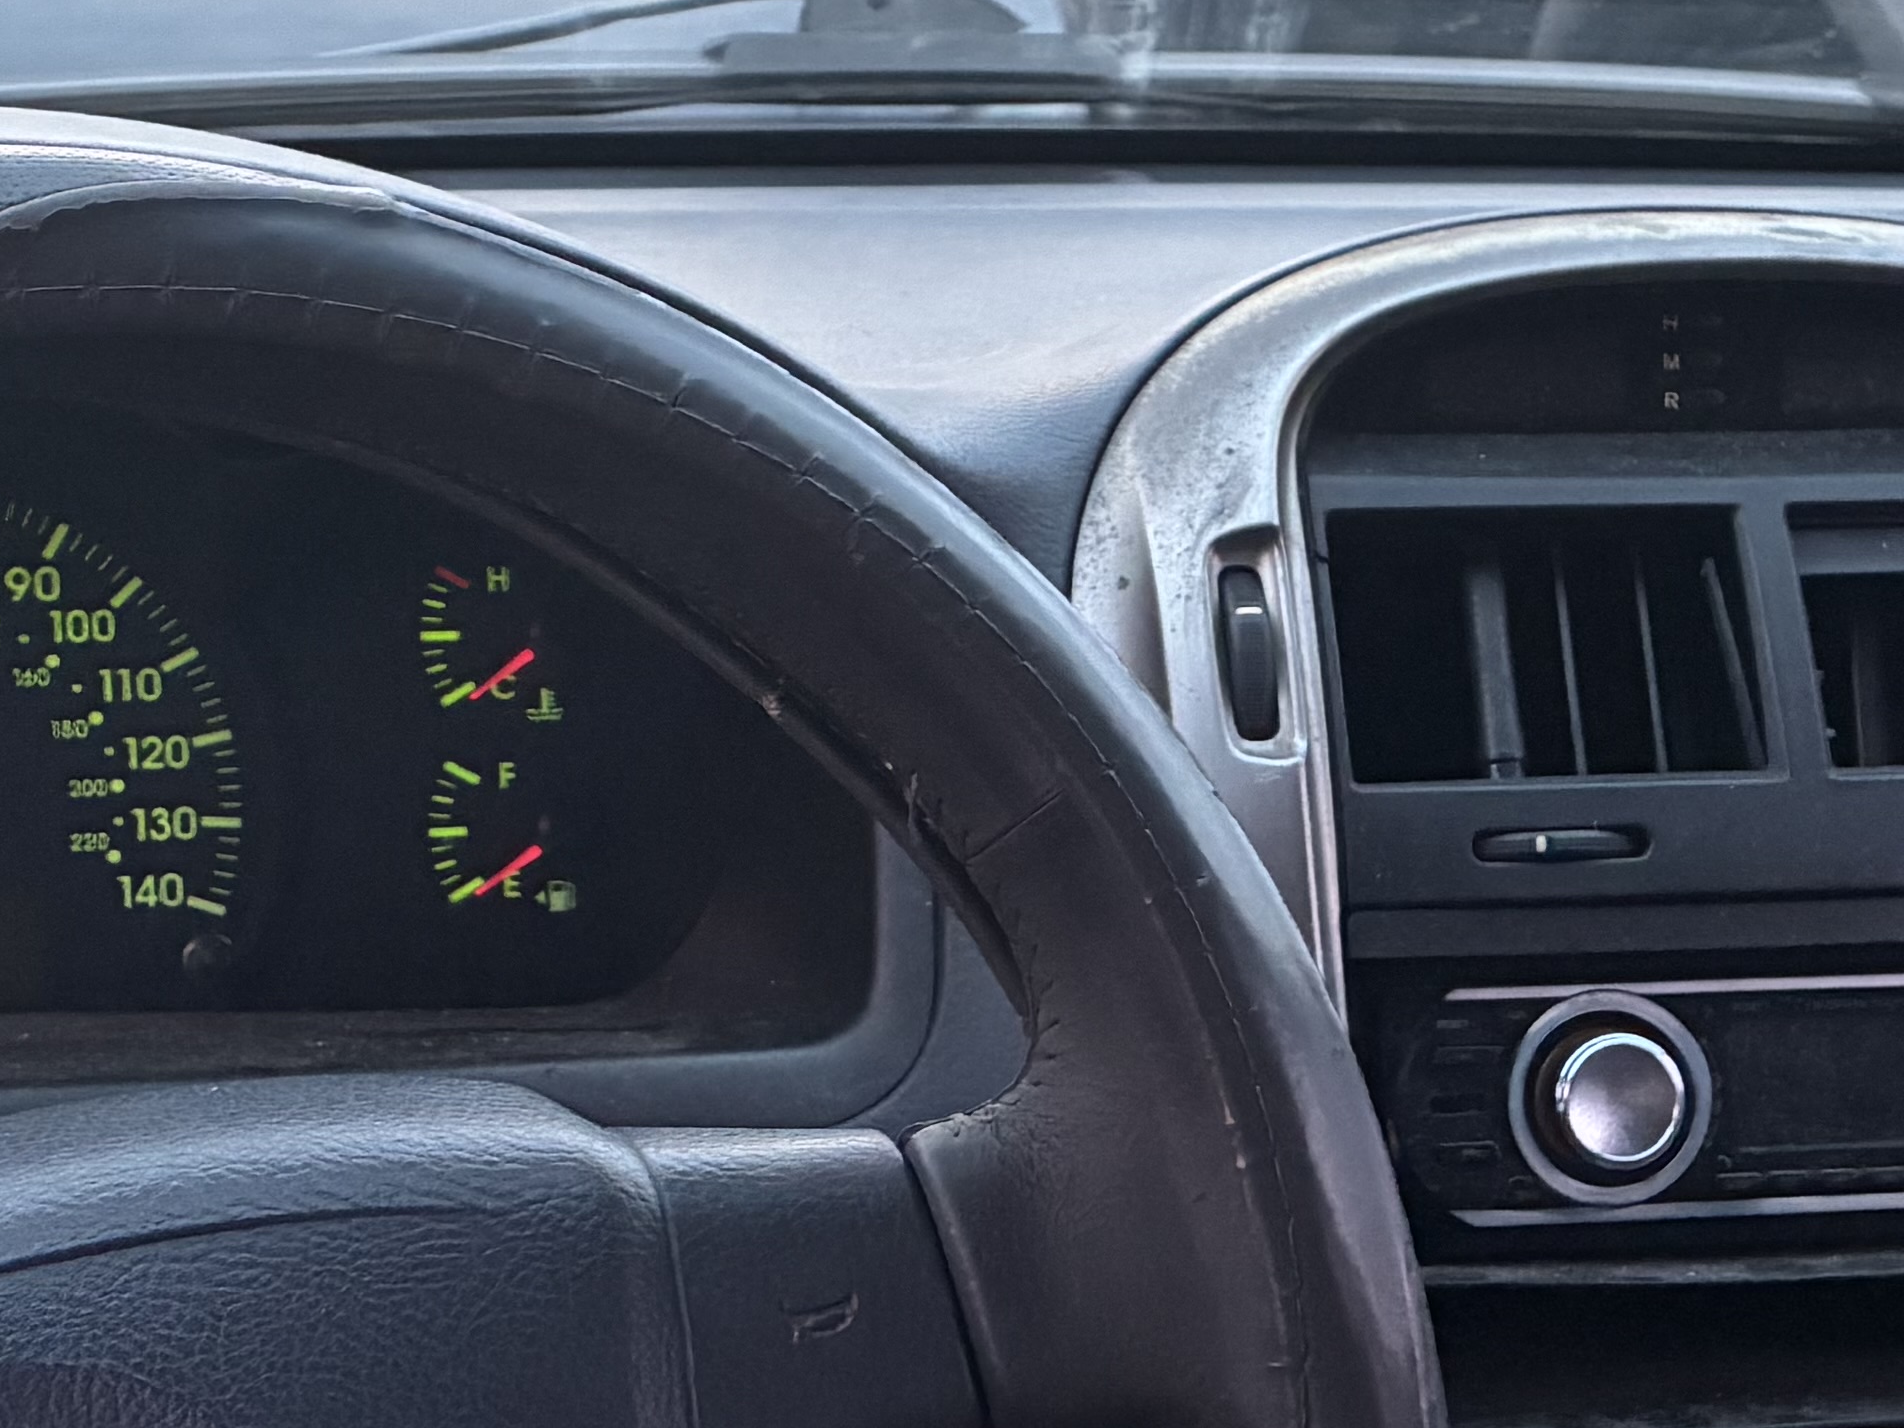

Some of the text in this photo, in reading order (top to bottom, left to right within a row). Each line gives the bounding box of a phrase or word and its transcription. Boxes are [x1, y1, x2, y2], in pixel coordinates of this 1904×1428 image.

[1663, 353, 1680, 370] M
[1664, 391, 1680, 410] R
[4, 566, 60, 602] 90
[487, 566, 511, 592] H
[49, 609, 115, 644] 100
[99, 668, 163, 703] 110
[491, 674, 517, 700] C
[123, 735, 190, 770] 120
[499, 762, 517, 789] F
[131, 806, 197, 842] 130
[119, 874, 185, 908] 140
[503, 871, 522, 898] E
